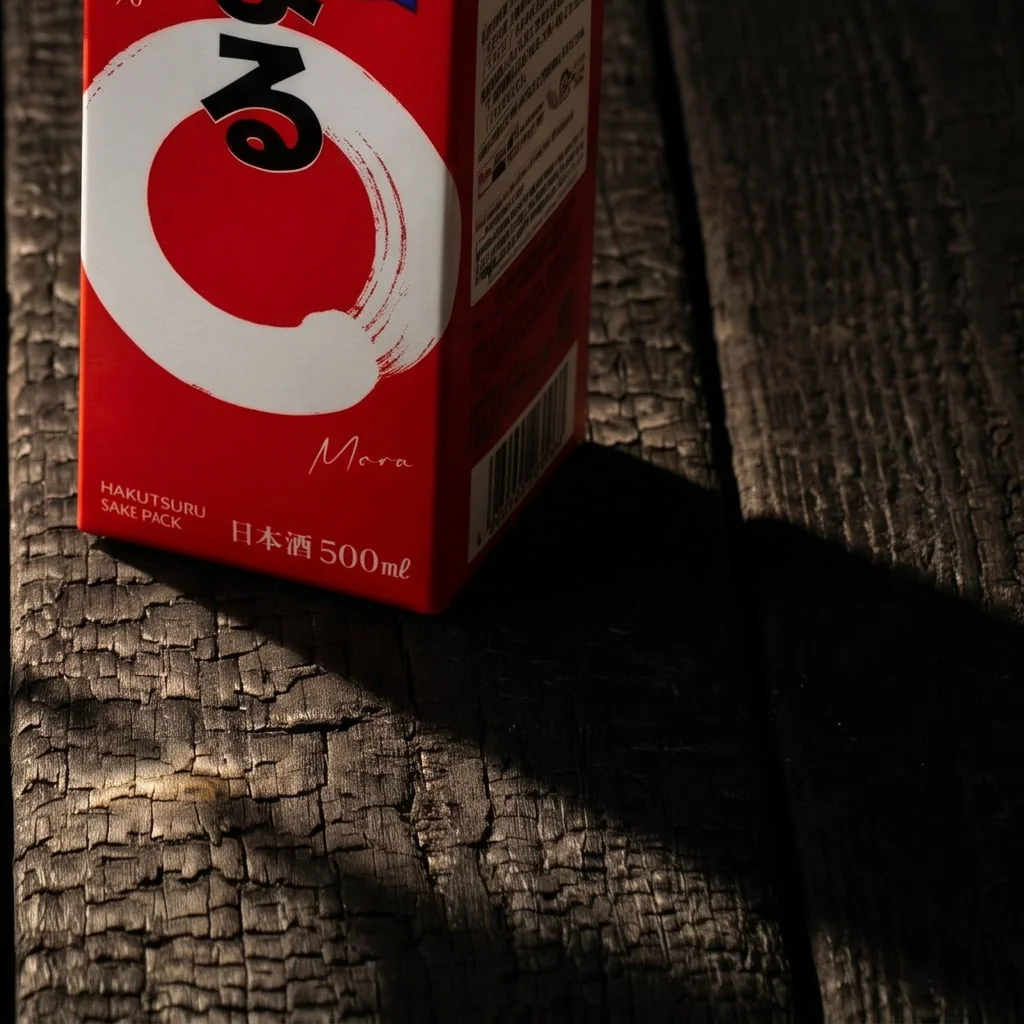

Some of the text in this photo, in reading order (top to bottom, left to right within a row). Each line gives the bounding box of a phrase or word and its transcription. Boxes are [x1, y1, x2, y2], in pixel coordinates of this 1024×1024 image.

[100, 480, 206, 519] HAKUTSURU
[100, 498, 183, 530] SAKE PACK
[232, 519, 312, 560] 日本酒
